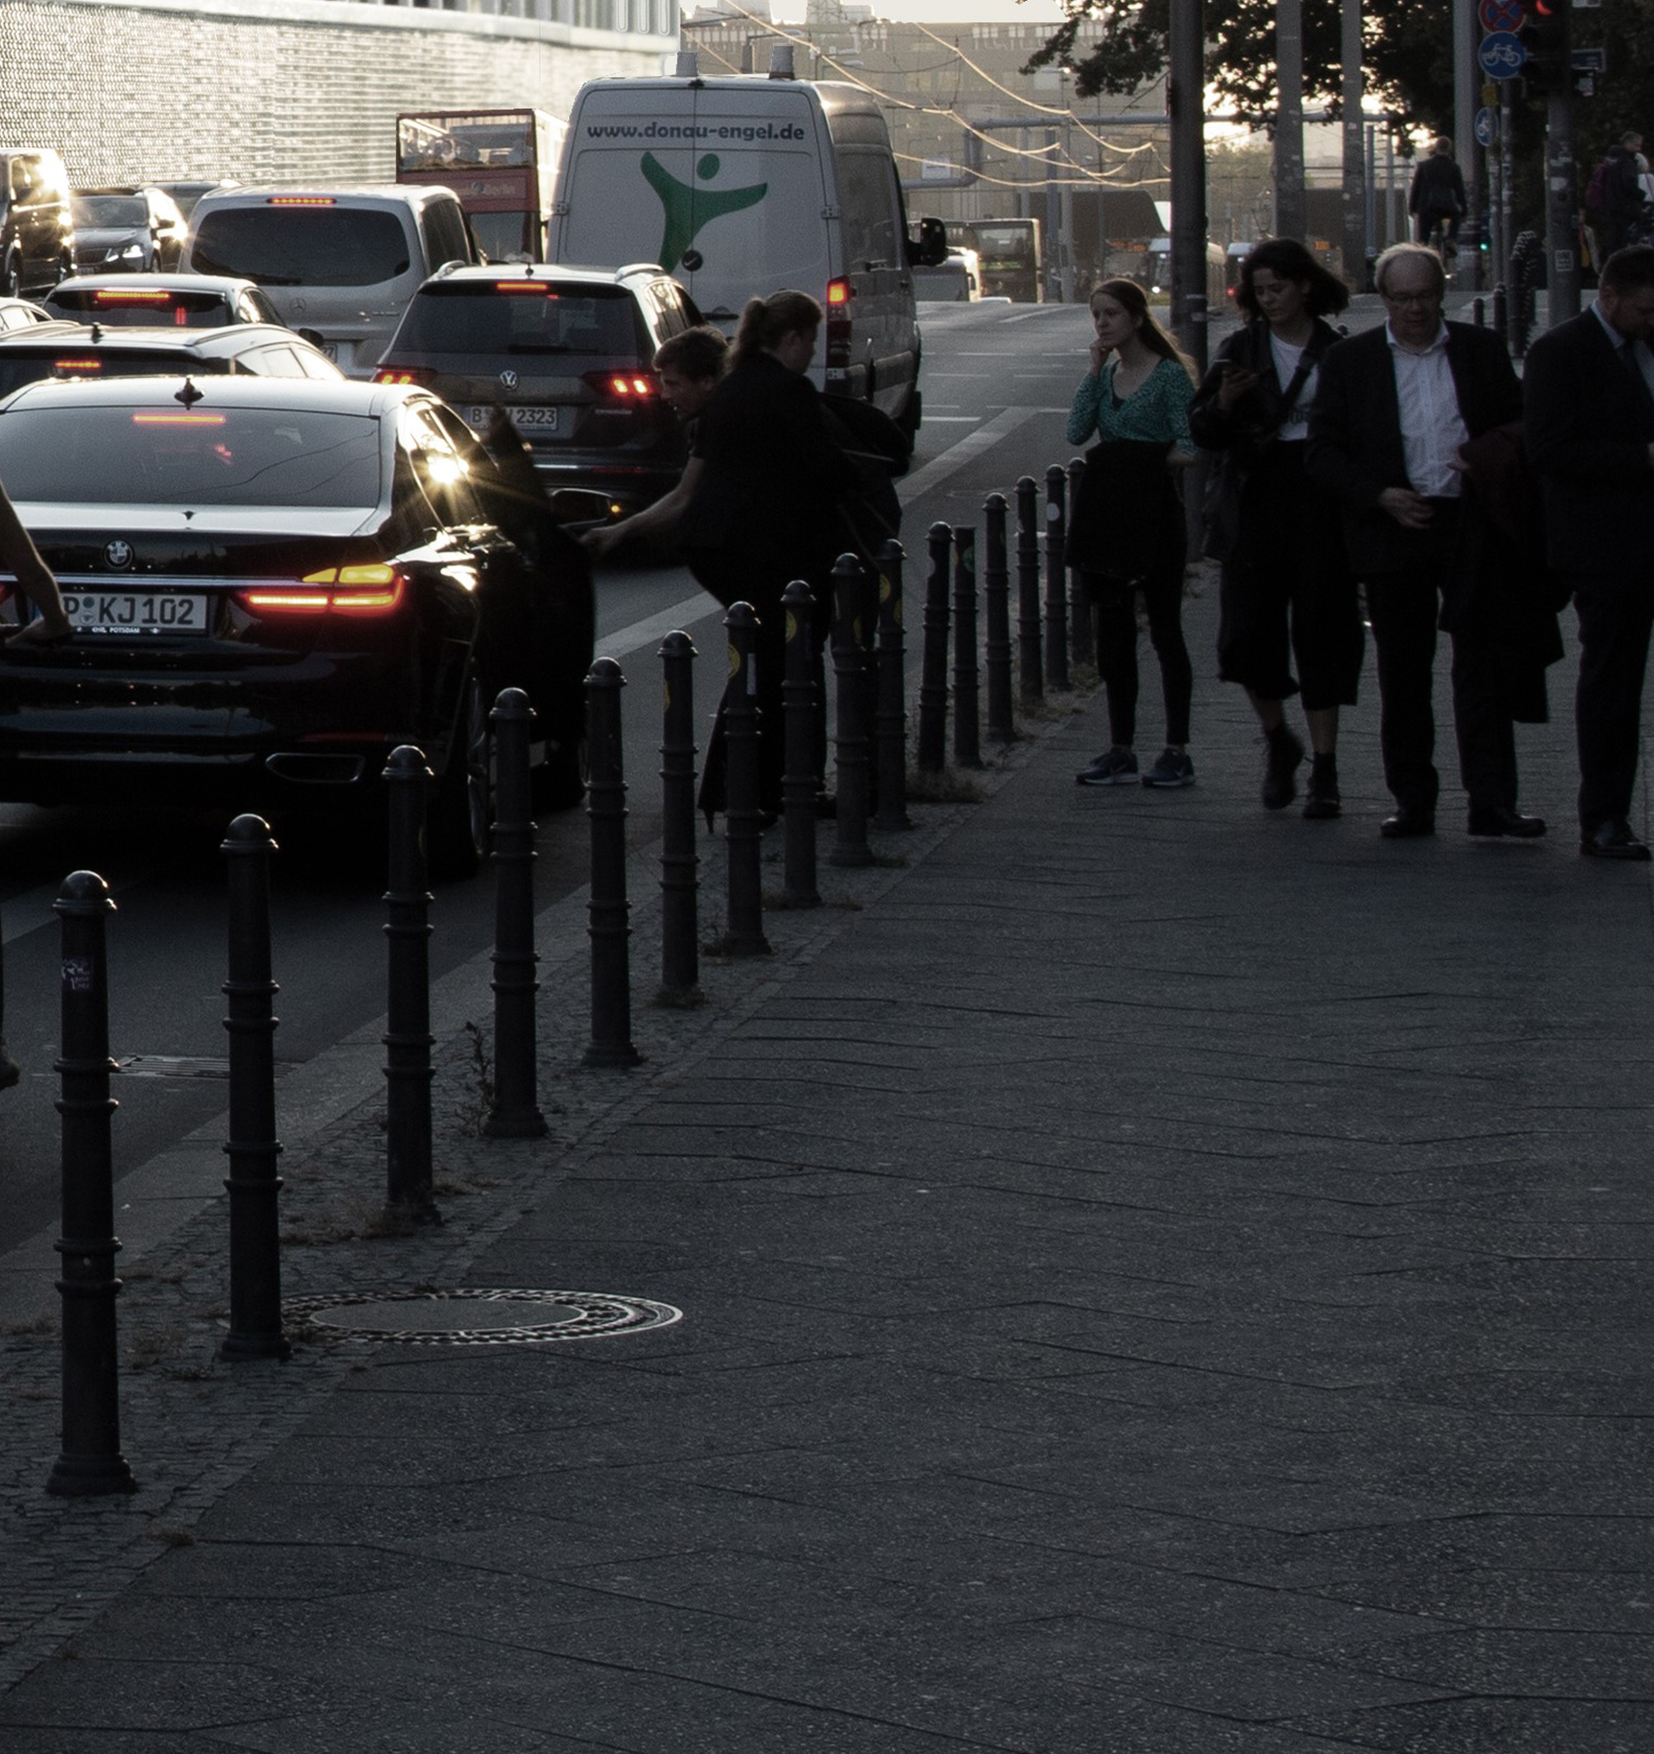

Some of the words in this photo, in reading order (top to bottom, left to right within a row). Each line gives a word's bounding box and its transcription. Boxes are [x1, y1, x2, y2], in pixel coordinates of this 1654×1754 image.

[587, 121, 805, 142] www.donau-engel.de
[516, 409, 556, 425] 2323
[99, 596, 136, 624] KJ
[141, 597, 194, 625] 102
